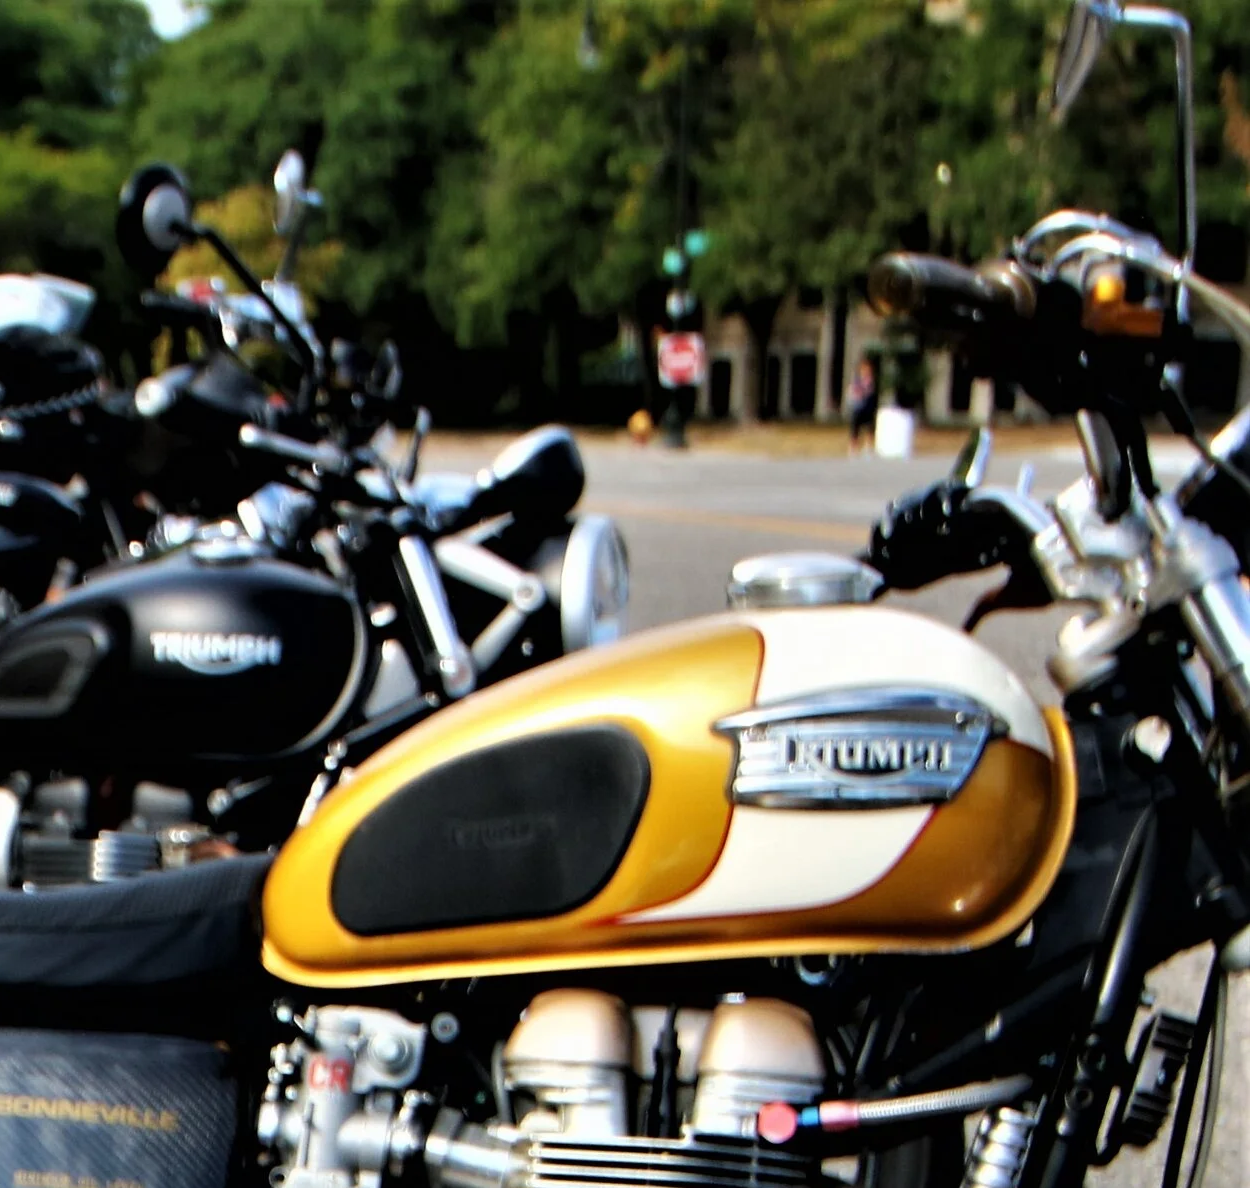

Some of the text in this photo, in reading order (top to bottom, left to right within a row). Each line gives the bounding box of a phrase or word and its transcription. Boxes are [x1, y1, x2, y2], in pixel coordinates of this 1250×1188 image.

[150, 632, 282, 671] TRIUMPH
[777, 731, 954, 783] TRIUMPH
[308, 1055, 350, 1096] CR
